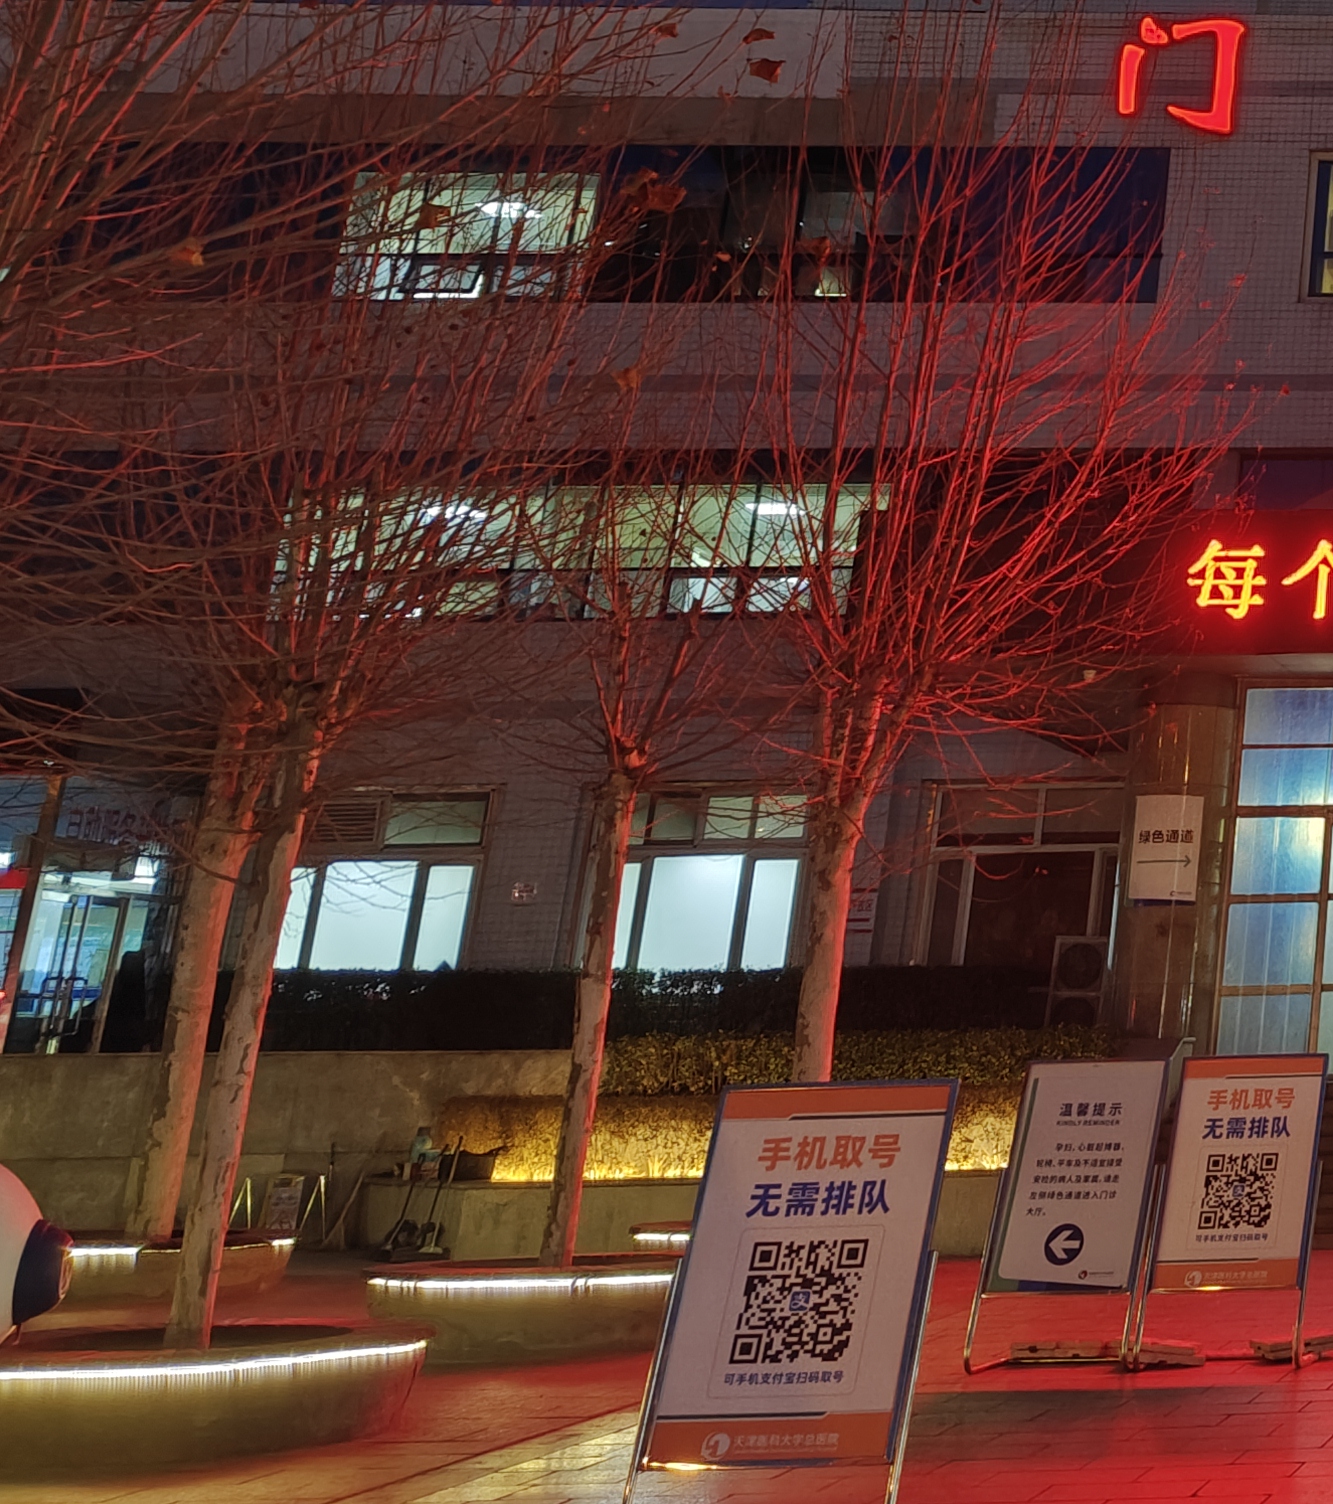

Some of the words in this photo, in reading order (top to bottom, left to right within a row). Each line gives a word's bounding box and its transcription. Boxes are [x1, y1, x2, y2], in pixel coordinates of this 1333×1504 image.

[1138, 829, 1194, 844] 绿色通道
[1059, 1102, 1124, 1117] 温馨提示
[1206, 1087, 1296, 1112] 手机取号
[1201, 1115, 1292, 1140] 无需排队
[757, 1133, 902, 1172] 手机取号
[745, 1178, 891, 1219] 无需排队
[723, 1370, 845, 1386] 可手机支付宝扫码取号
